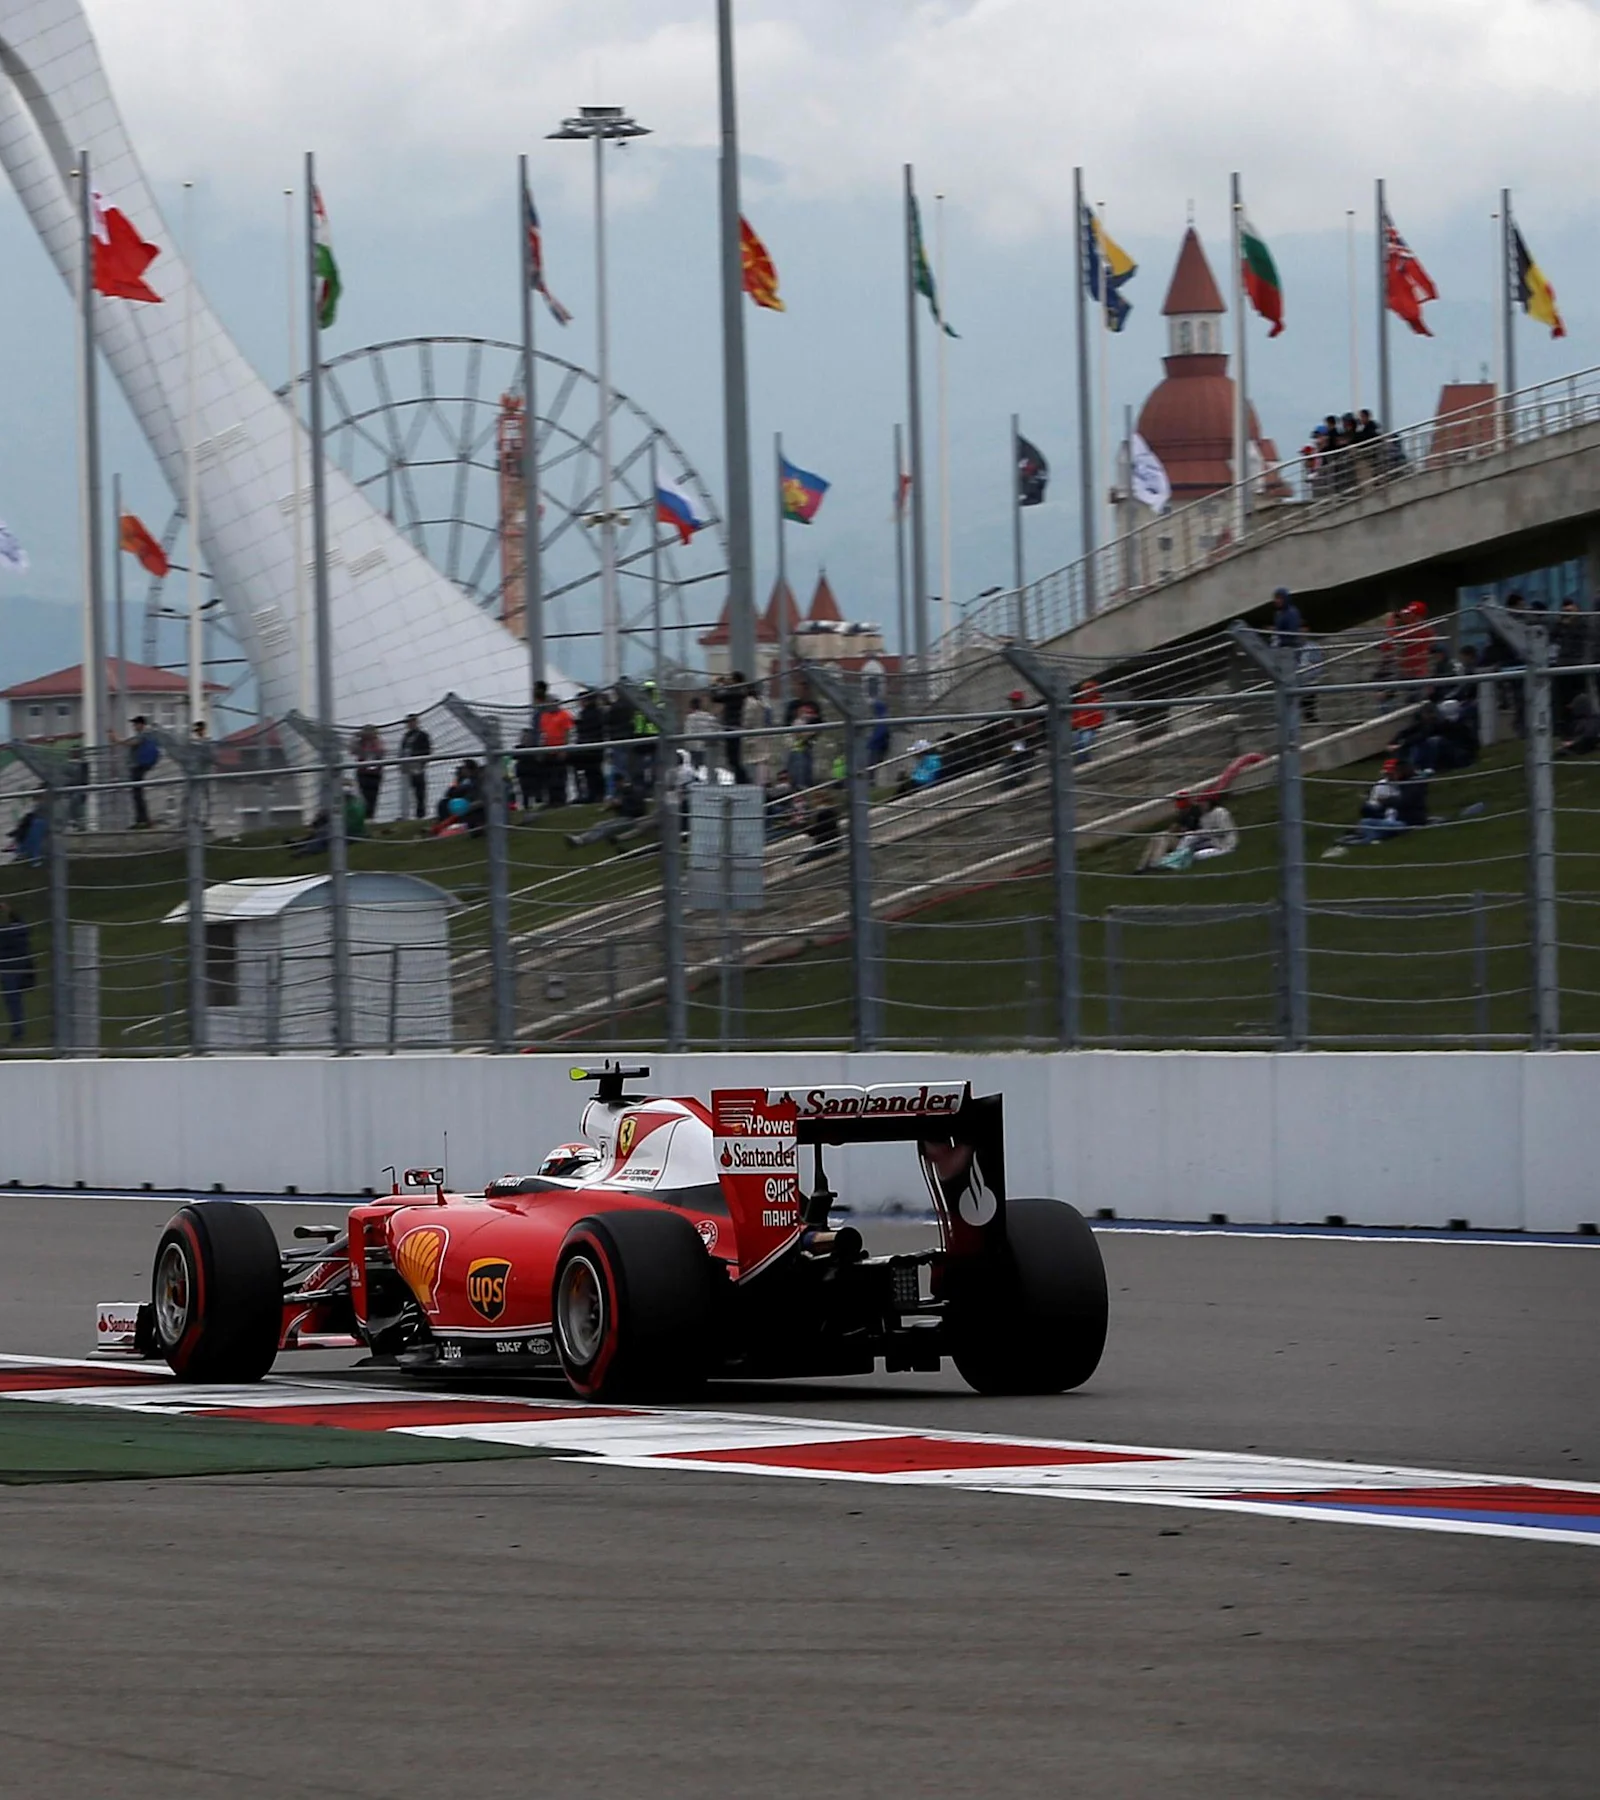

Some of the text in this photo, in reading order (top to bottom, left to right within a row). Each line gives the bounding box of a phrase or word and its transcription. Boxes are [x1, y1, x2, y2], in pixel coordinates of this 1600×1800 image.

[803, 1086, 959, 1116] Santander
[733, 1140, 796, 1168] Santander
[470, 1276, 504, 1313] ups
[495, 1341, 522, 1353] SKF
